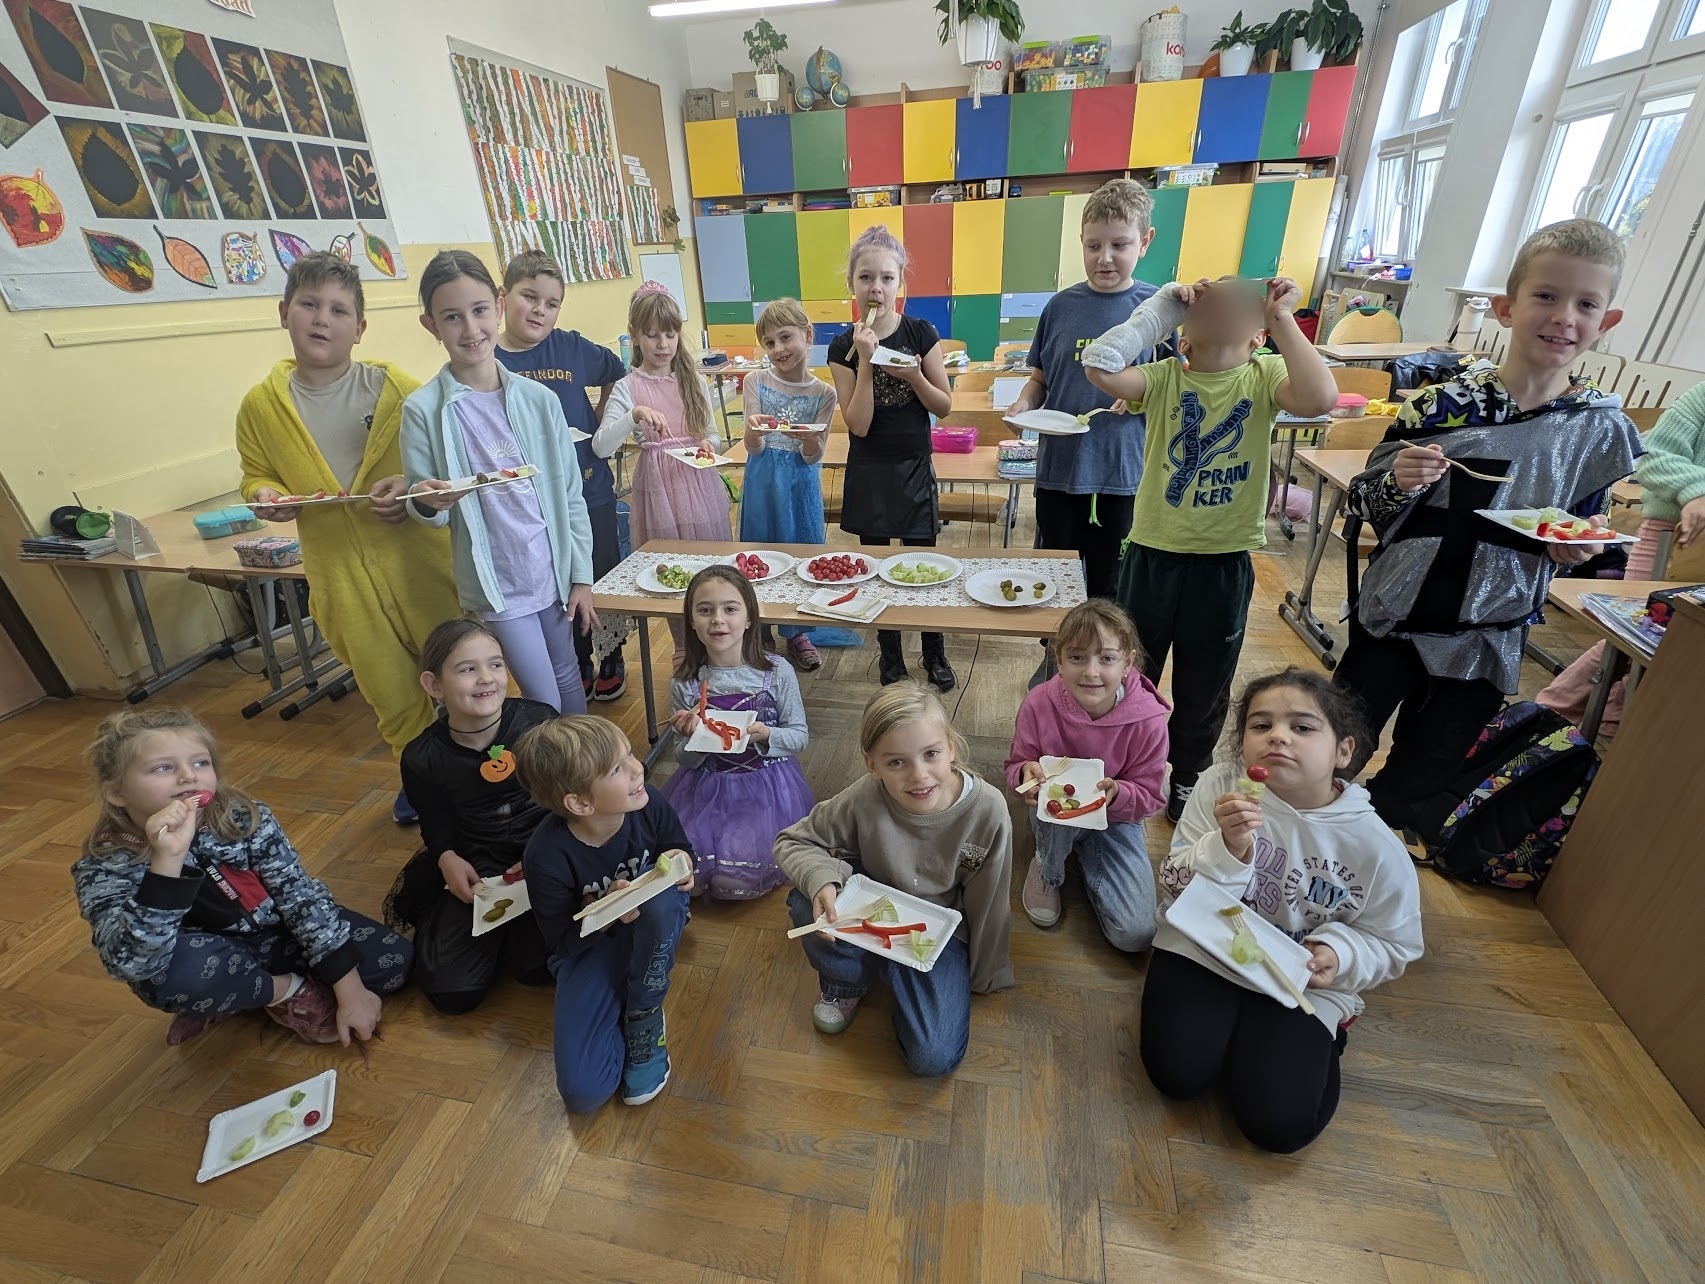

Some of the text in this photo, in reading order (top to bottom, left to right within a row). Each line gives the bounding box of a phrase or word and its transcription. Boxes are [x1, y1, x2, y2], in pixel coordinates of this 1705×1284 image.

[1198, 461, 1250, 487] PRAN
[1193, 487, 1233, 508] KER
[1285, 868, 1304, 912] UNITED
[1303, 857, 1355, 882] STATES
[1350, 885, 1364, 900] OF
[1304, 876, 1348, 909] NY
